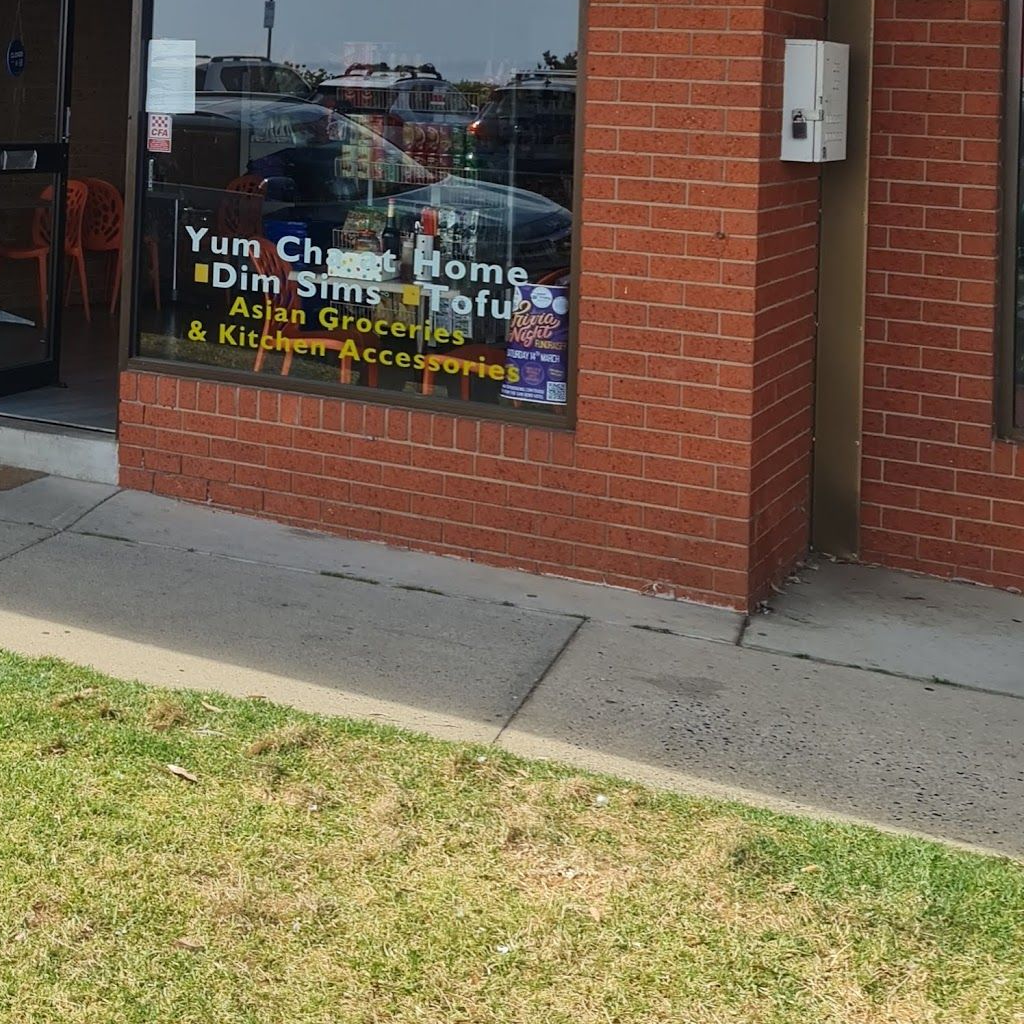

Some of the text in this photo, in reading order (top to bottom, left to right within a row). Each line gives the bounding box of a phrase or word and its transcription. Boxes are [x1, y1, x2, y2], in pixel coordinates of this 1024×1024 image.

[151, 128, 168, 137] CFA
[185, 225, 262, 259] Yum
[413, 248, 529, 286] Home
[212, 262, 512, 320] Dim Sims Tofu
[509, 299, 561, 329] Trivia
[229, 296, 466, 347] Asian Groceries
[508, 325, 553, 348] Night
[187, 319, 207, 342] &
[218, 322, 326, 357] Kitchen
[338, 338, 521, 384] Accessories
